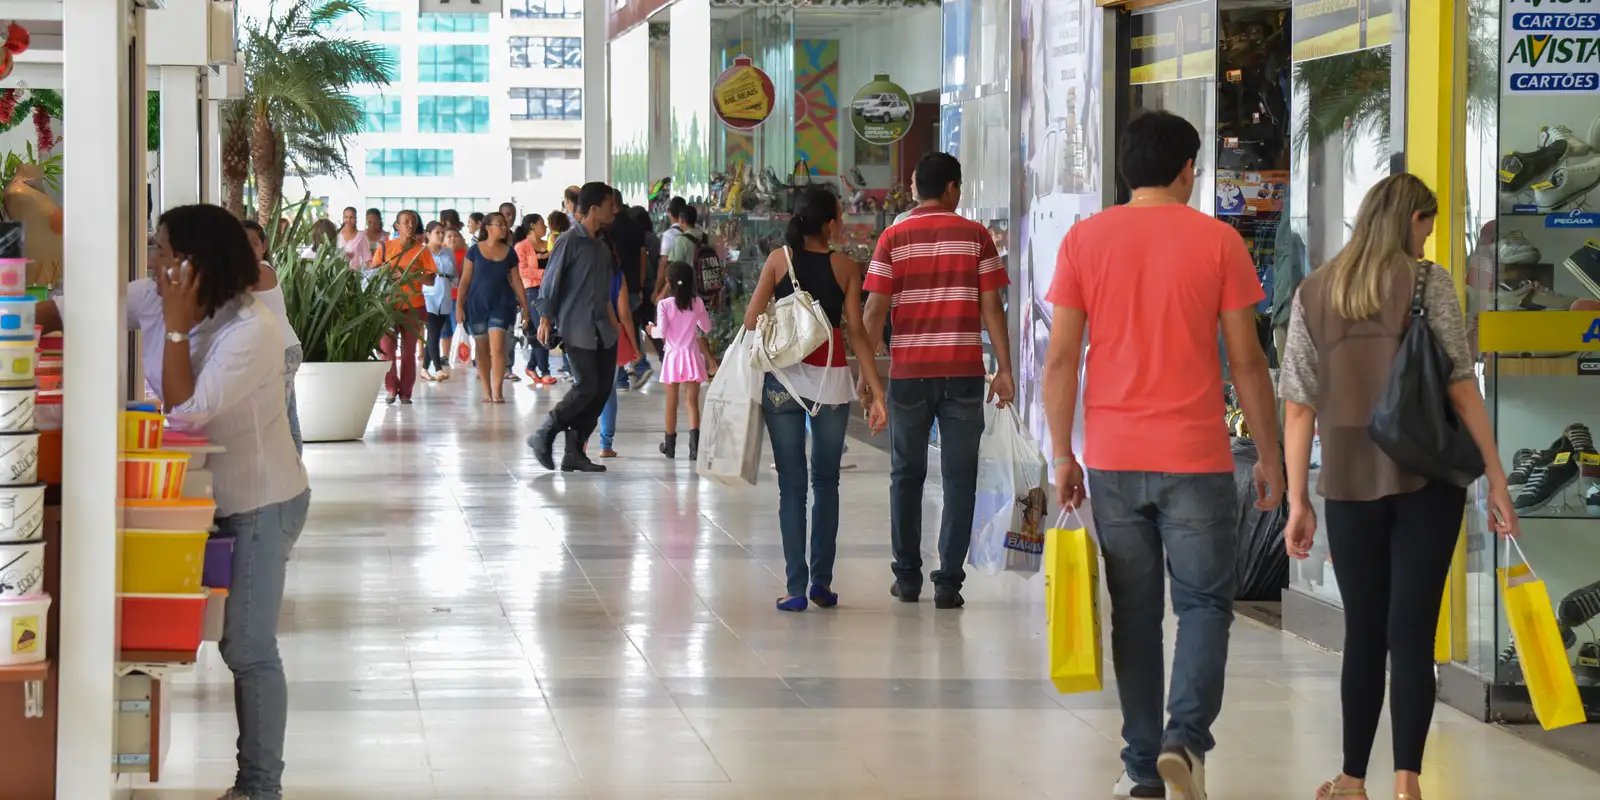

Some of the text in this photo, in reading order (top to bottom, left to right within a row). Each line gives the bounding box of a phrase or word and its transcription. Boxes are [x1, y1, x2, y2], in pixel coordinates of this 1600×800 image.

[1519, 13, 1597, 28] CARTÕES
[1507, 34, 1600, 68] AVISTA
[1516, 72, 1594, 88] CARTÕES
[737, 88, 758, 100] REAIS
